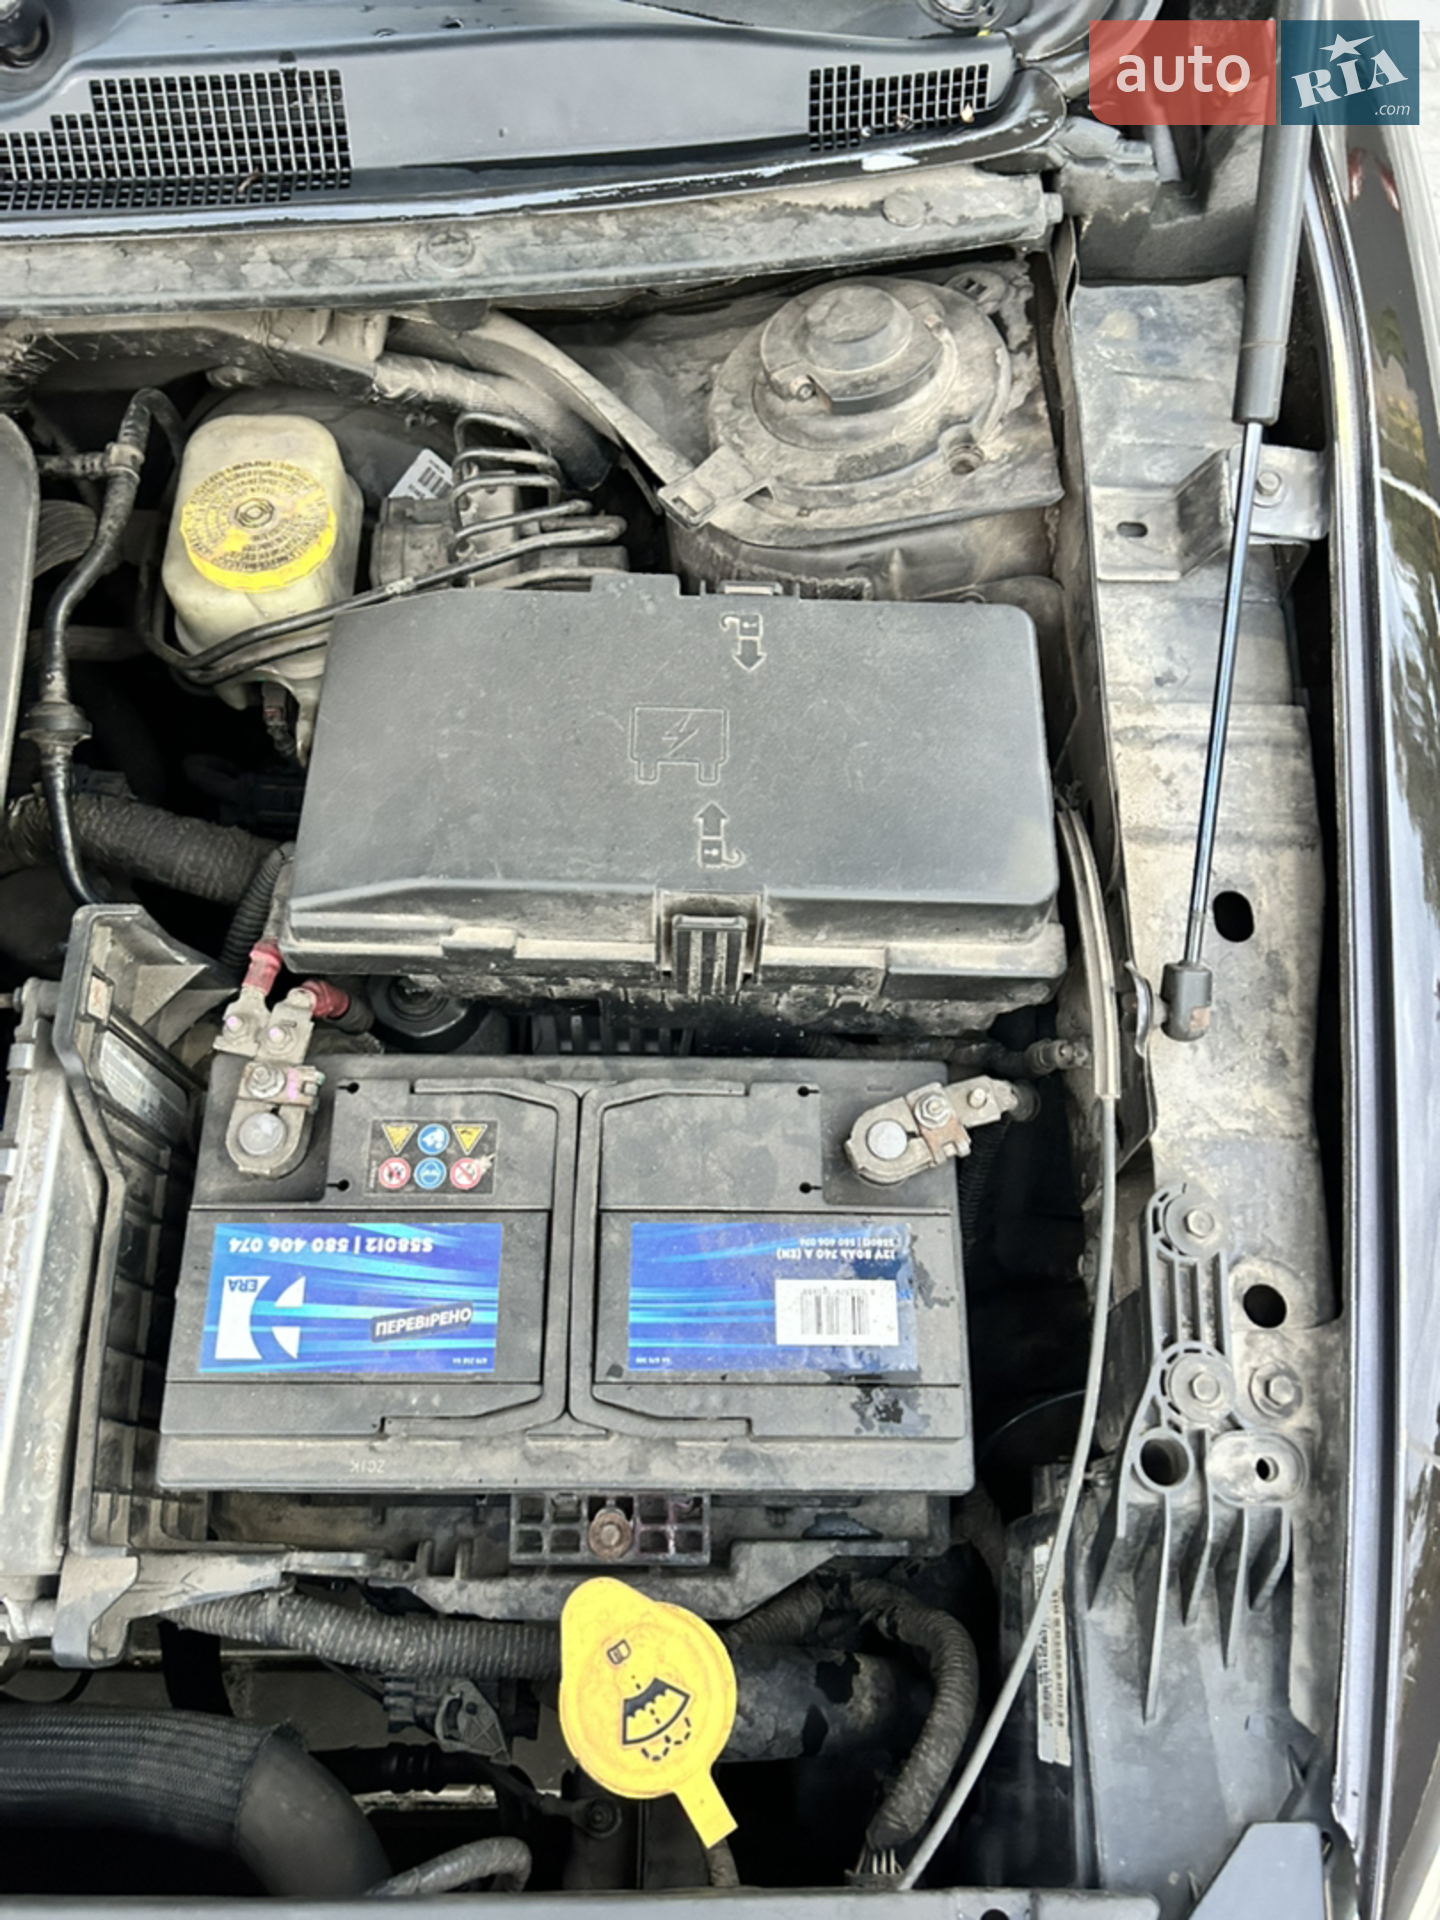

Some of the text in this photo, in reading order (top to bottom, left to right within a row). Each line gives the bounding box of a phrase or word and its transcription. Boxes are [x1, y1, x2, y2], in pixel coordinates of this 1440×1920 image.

[229, 1237, 263, 1253] 074
[267, 1237, 307, 1253] 406
[312, 1237, 349, 1253] 580
[364, 1237, 434, 1253] S58012
[804, 1248, 813, 1260] A
[815, 1248, 838, 1260] 740
[840, 1248, 872, 1260] 80Ah
[874, 1248, 896, 1260] 12V
[228, 1278, 258, 1292] ERA
[375, 1307, 472, 1336] ПЕРЕВІРЕНО
